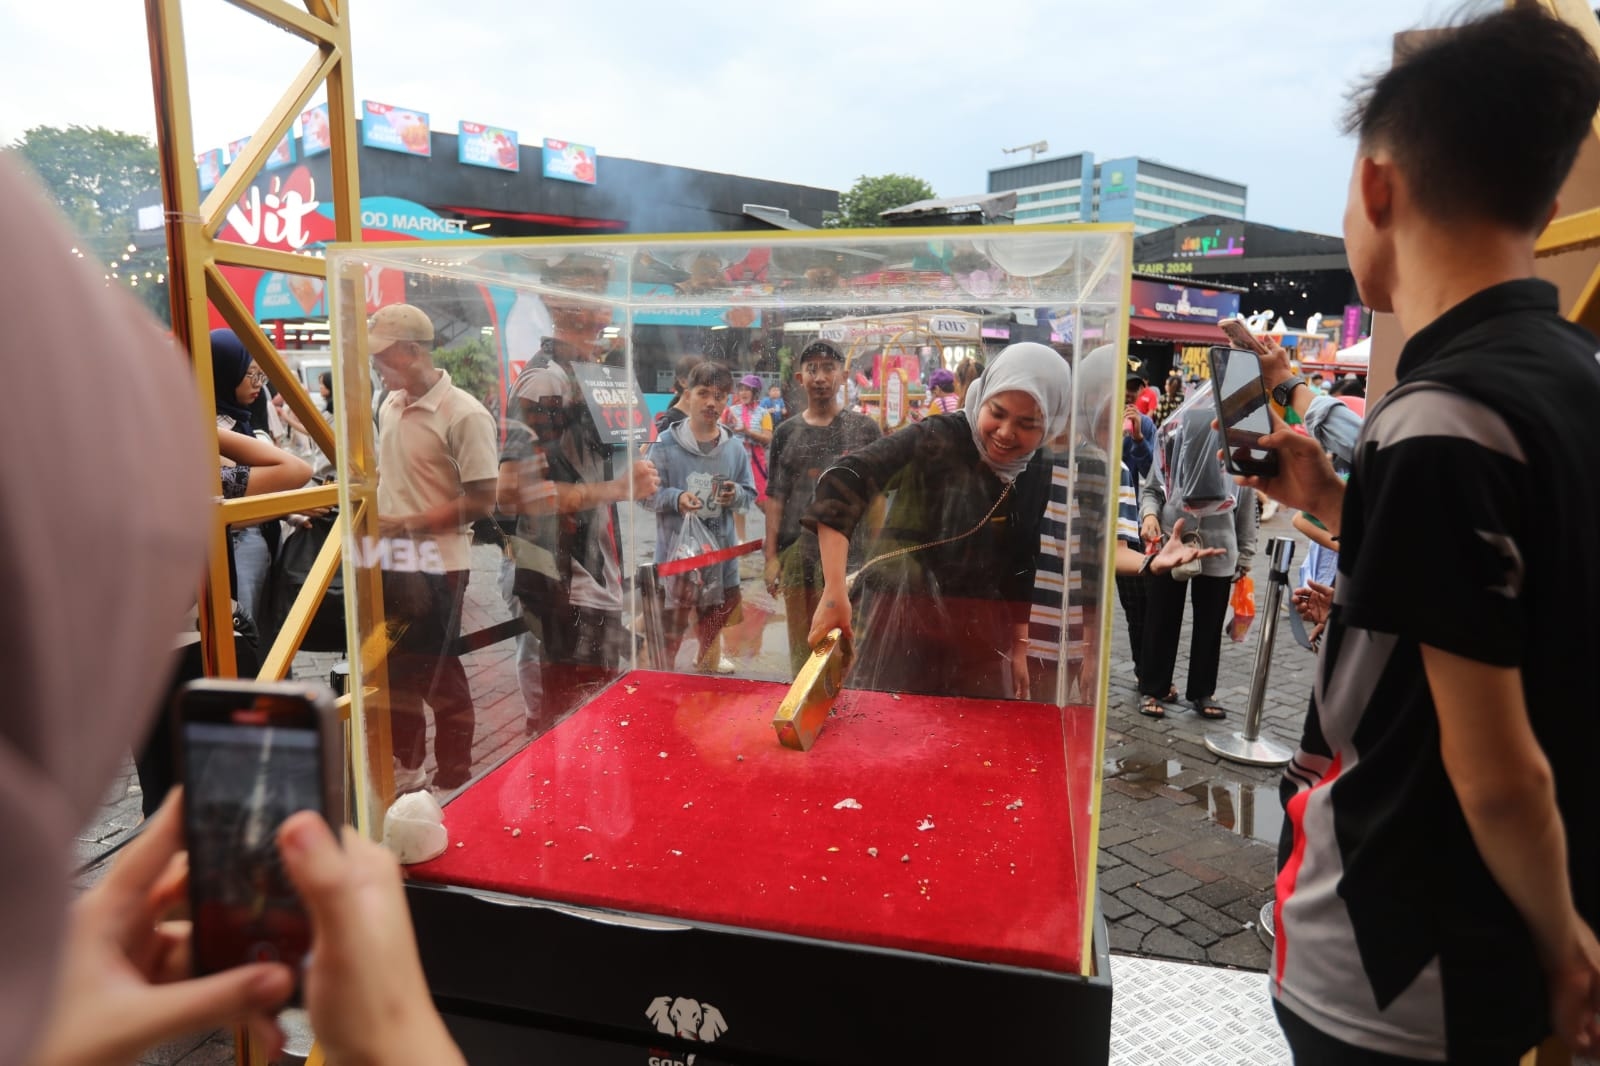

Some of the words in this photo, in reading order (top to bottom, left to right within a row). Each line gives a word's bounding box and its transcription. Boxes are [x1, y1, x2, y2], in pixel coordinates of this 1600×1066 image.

[226, 185, 320, 249] Vit
[361, 211, 388, 227] OD
[392, 214, 467, 234] MARKET
[1138, 263, 1164, 273] FAIR
[1167, 262, 1193, 273] 2024
